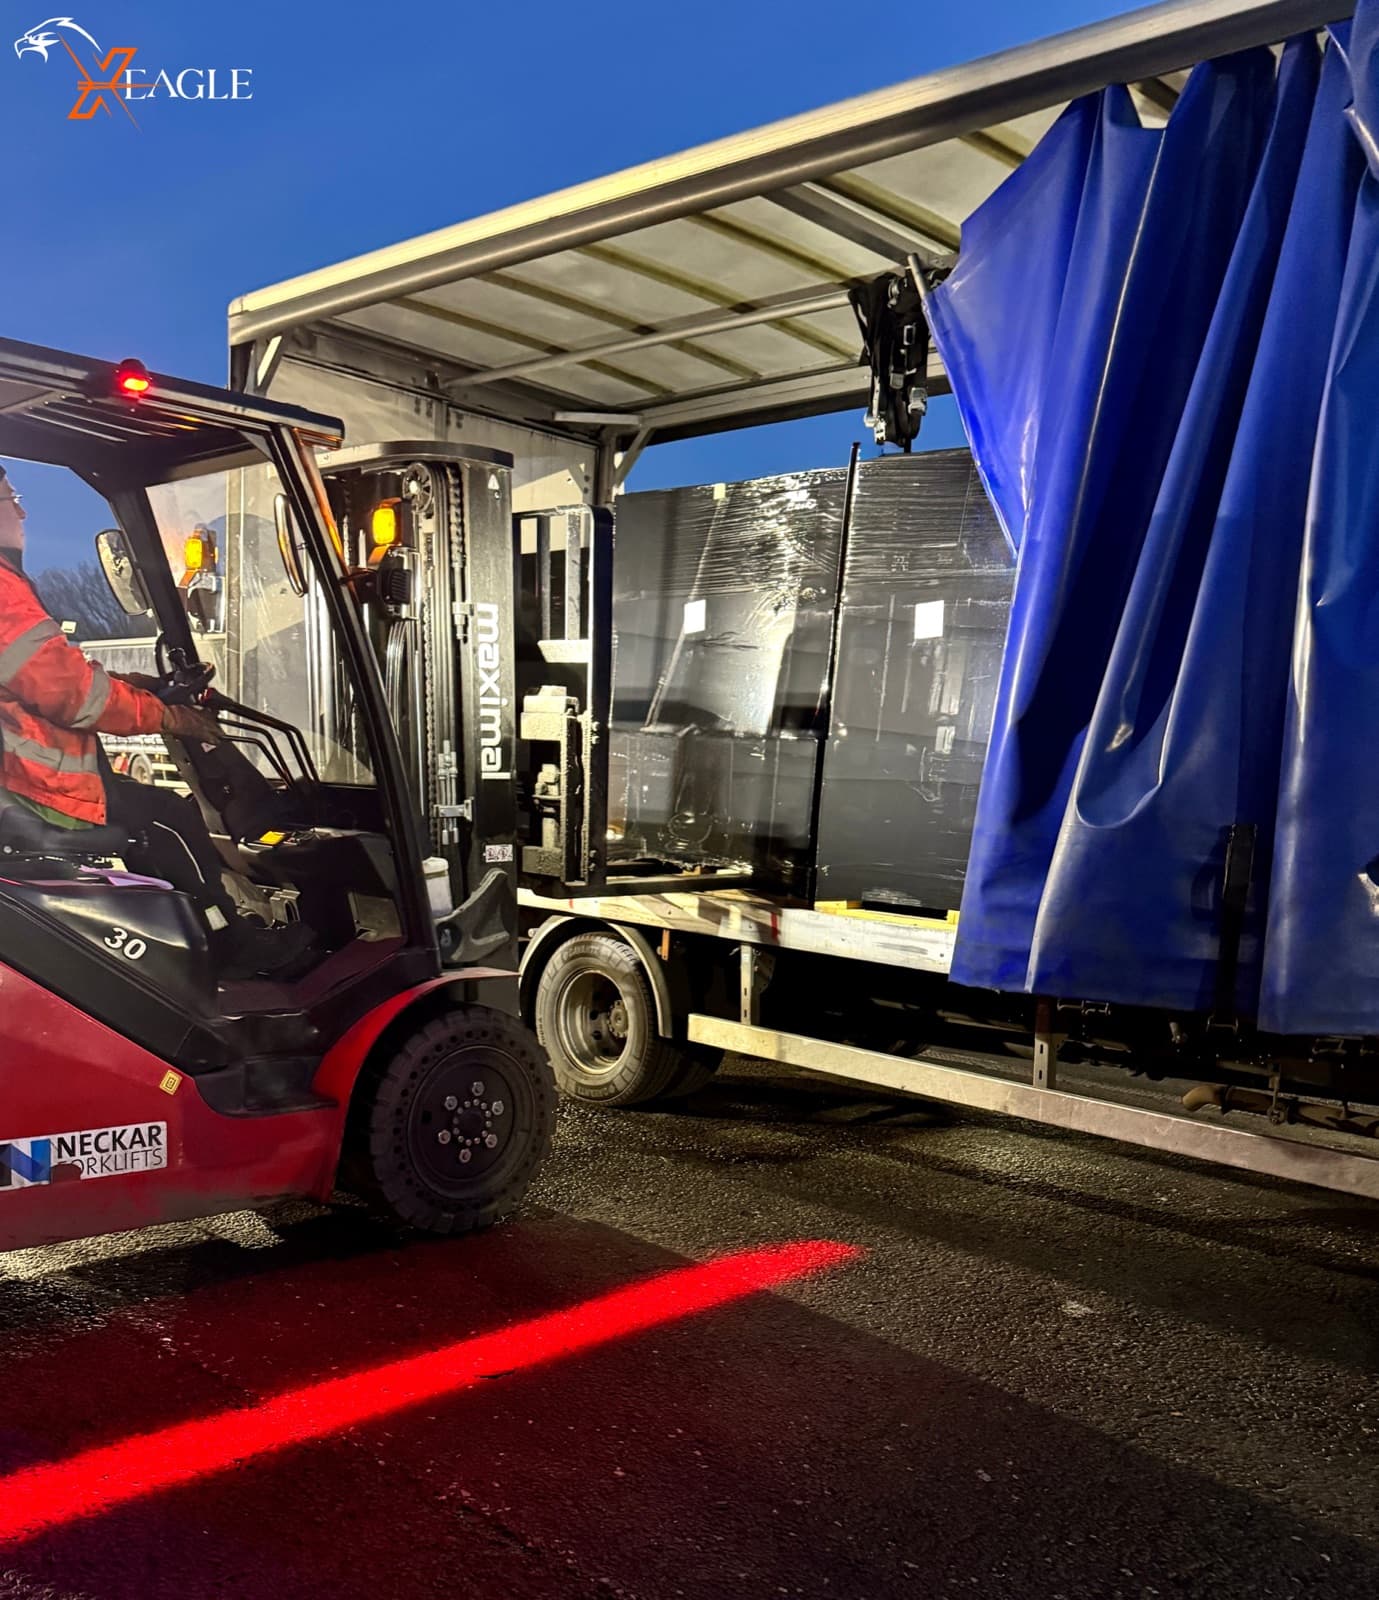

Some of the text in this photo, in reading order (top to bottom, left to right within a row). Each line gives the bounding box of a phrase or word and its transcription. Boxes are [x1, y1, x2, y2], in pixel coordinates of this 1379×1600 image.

[477, 602, 512, 780] maximal
[103, 927, 147, 961] 30
[57, 1125, 163, 1159] NECKAR
[59, 1147, 164, 1176] ORKLIFTS
